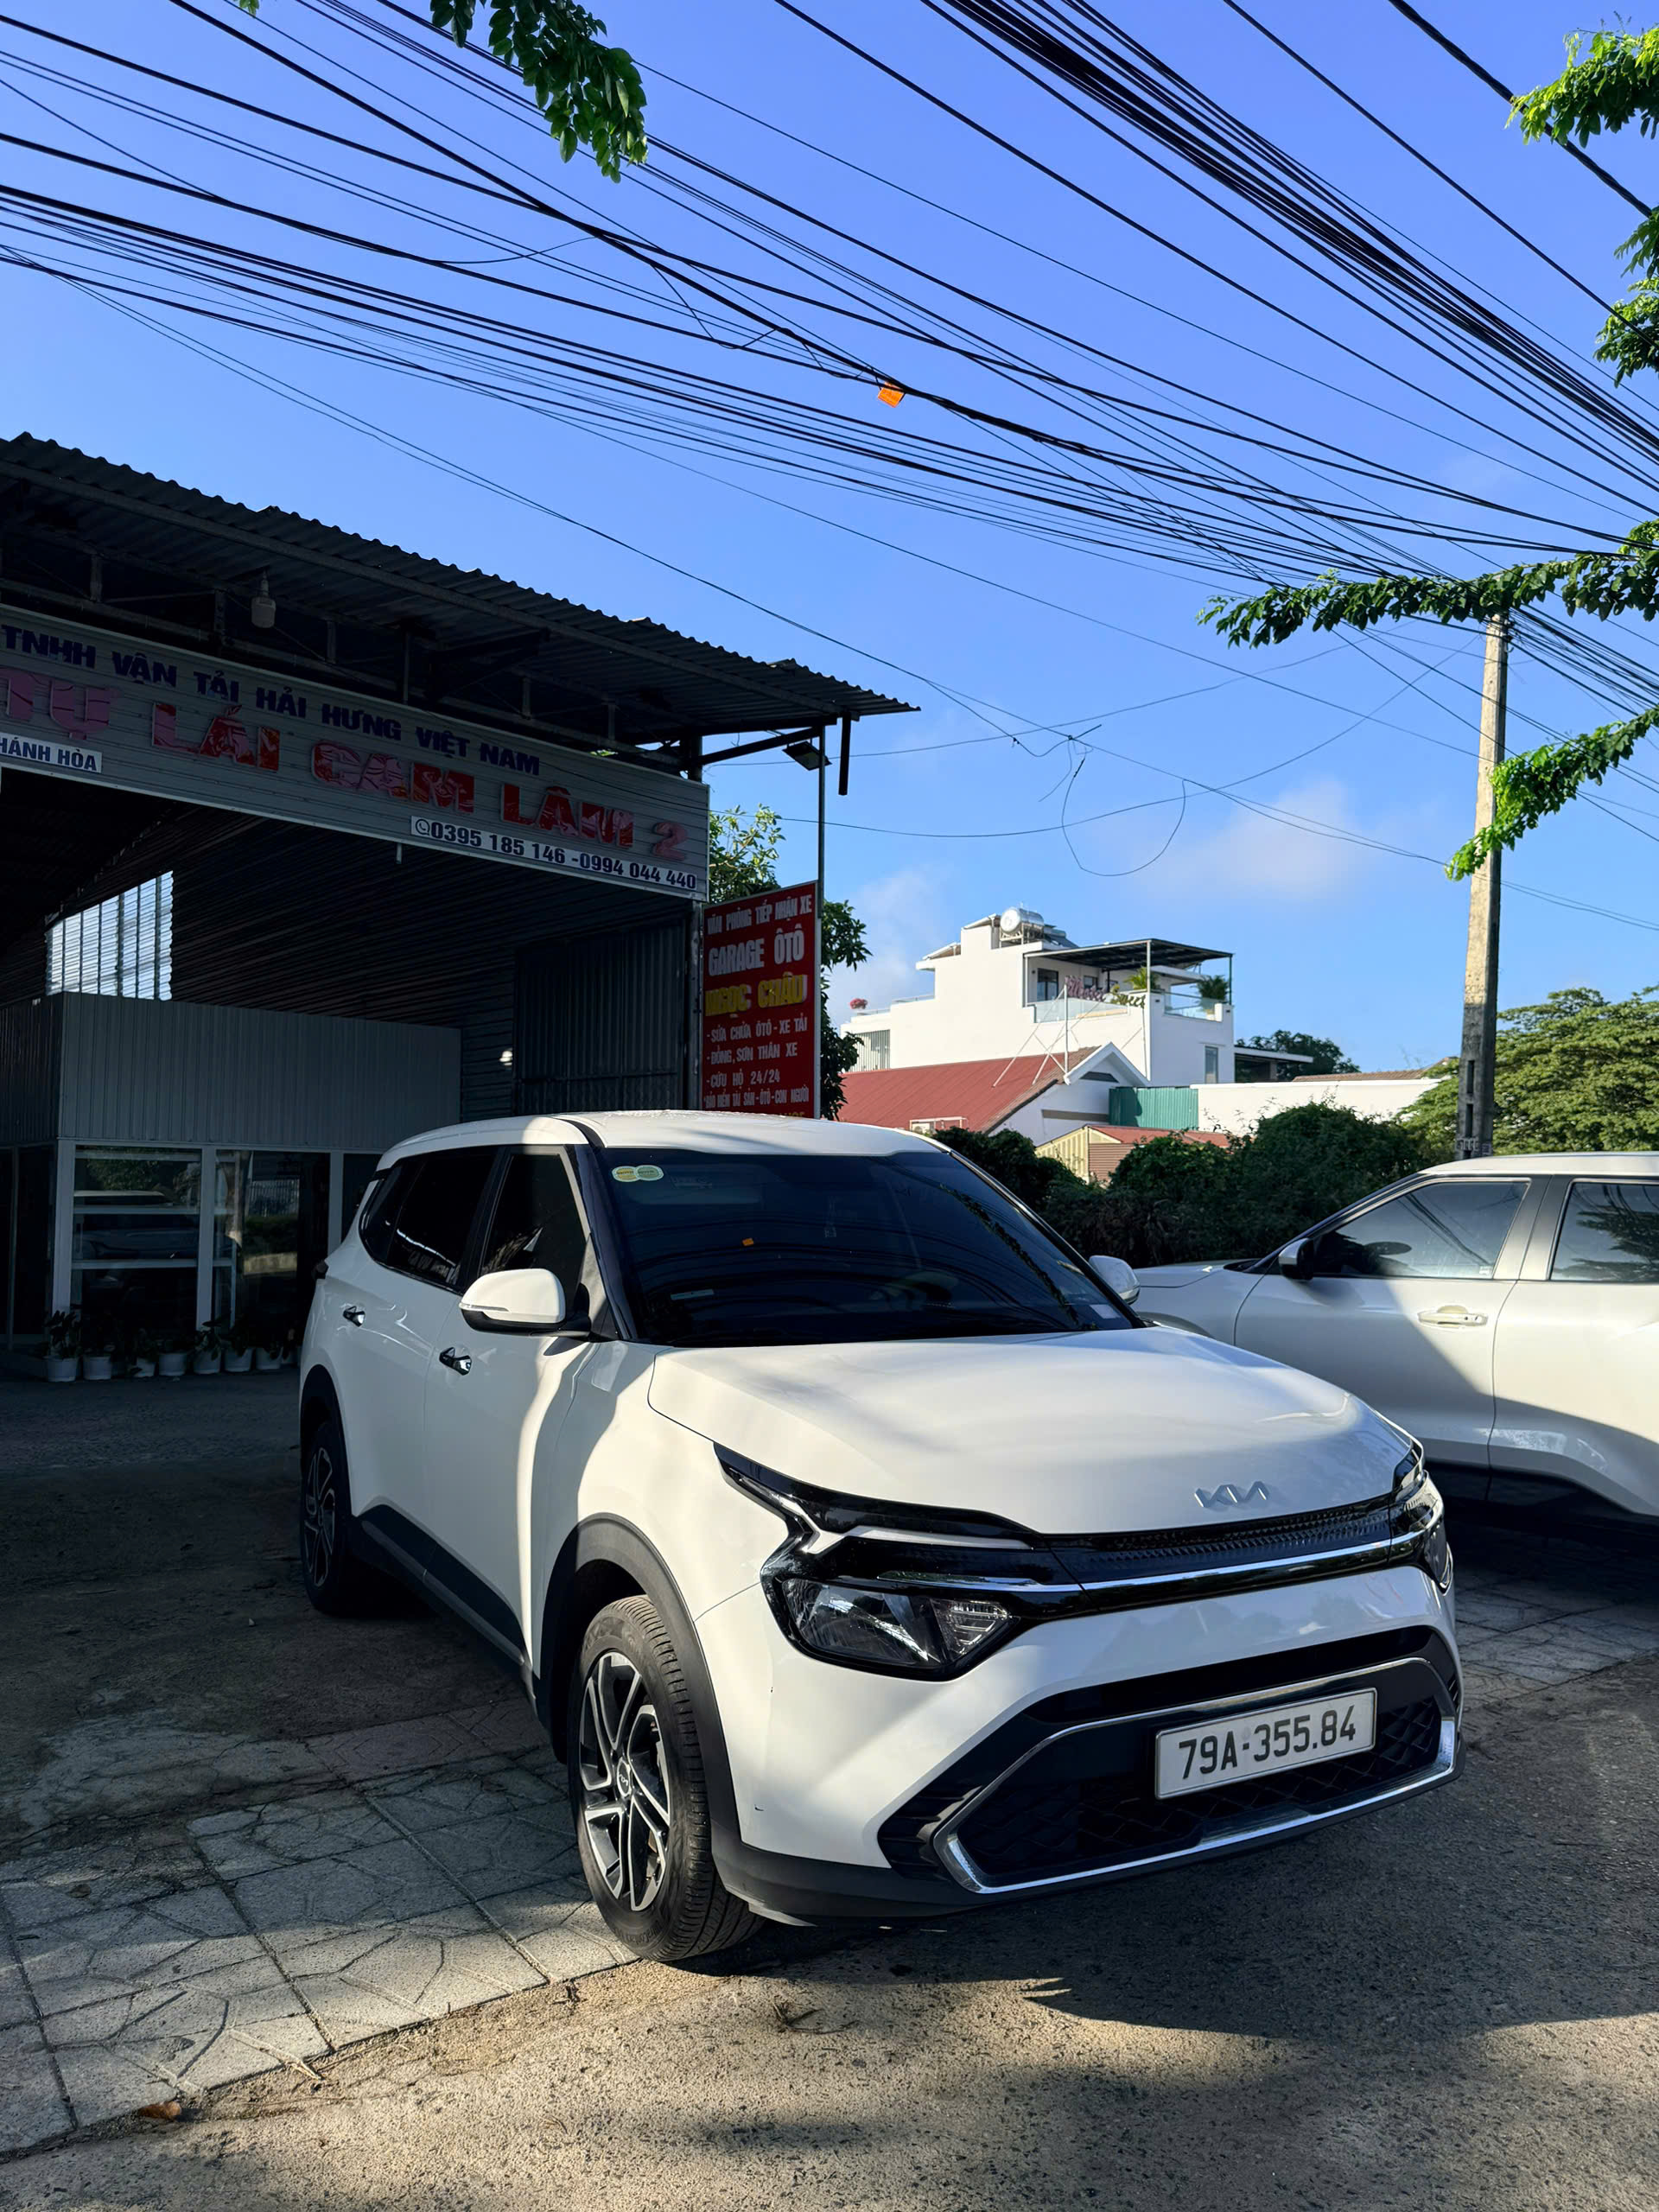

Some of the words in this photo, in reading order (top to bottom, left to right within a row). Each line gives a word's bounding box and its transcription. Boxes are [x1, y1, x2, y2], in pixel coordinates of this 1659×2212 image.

[2, 625, 96, 669] TNHH
[111, 652, 177, 688] VẬN
[194, 670, 238, 702] TẢI
[257, 686, 308, 719] HẢI
[321, 703, 401, 741] HƯNG
[416, 727, 470, 759] VIỆT
[480, 742, 539, 776] NAM
[57, 748, 97, 772] HÒA
[151, 702, 280, 772] LÁI
[312, 740, 474, 813] CAM
[500, 783, 634, 849] LÂM
[652, 821, 689, 862] 2
[431, 822, 481, 847] 0395
[489, 834, 524, 856] 185
[532, 843, 565, 864] 146
[630, 862, 661, 883] 044
[666, 872, 696, 890] 440
[799, 894, 812, 915] XE
[709, 938, 765, 976] GARAGE
[774, 923, 804, 965] ÔTÔ
[785, 1041, 798, 1058] XE
[750, 1068, 781, 1085] 24/24
[1179, 1705, 1356, 1780] 79A-355.84
